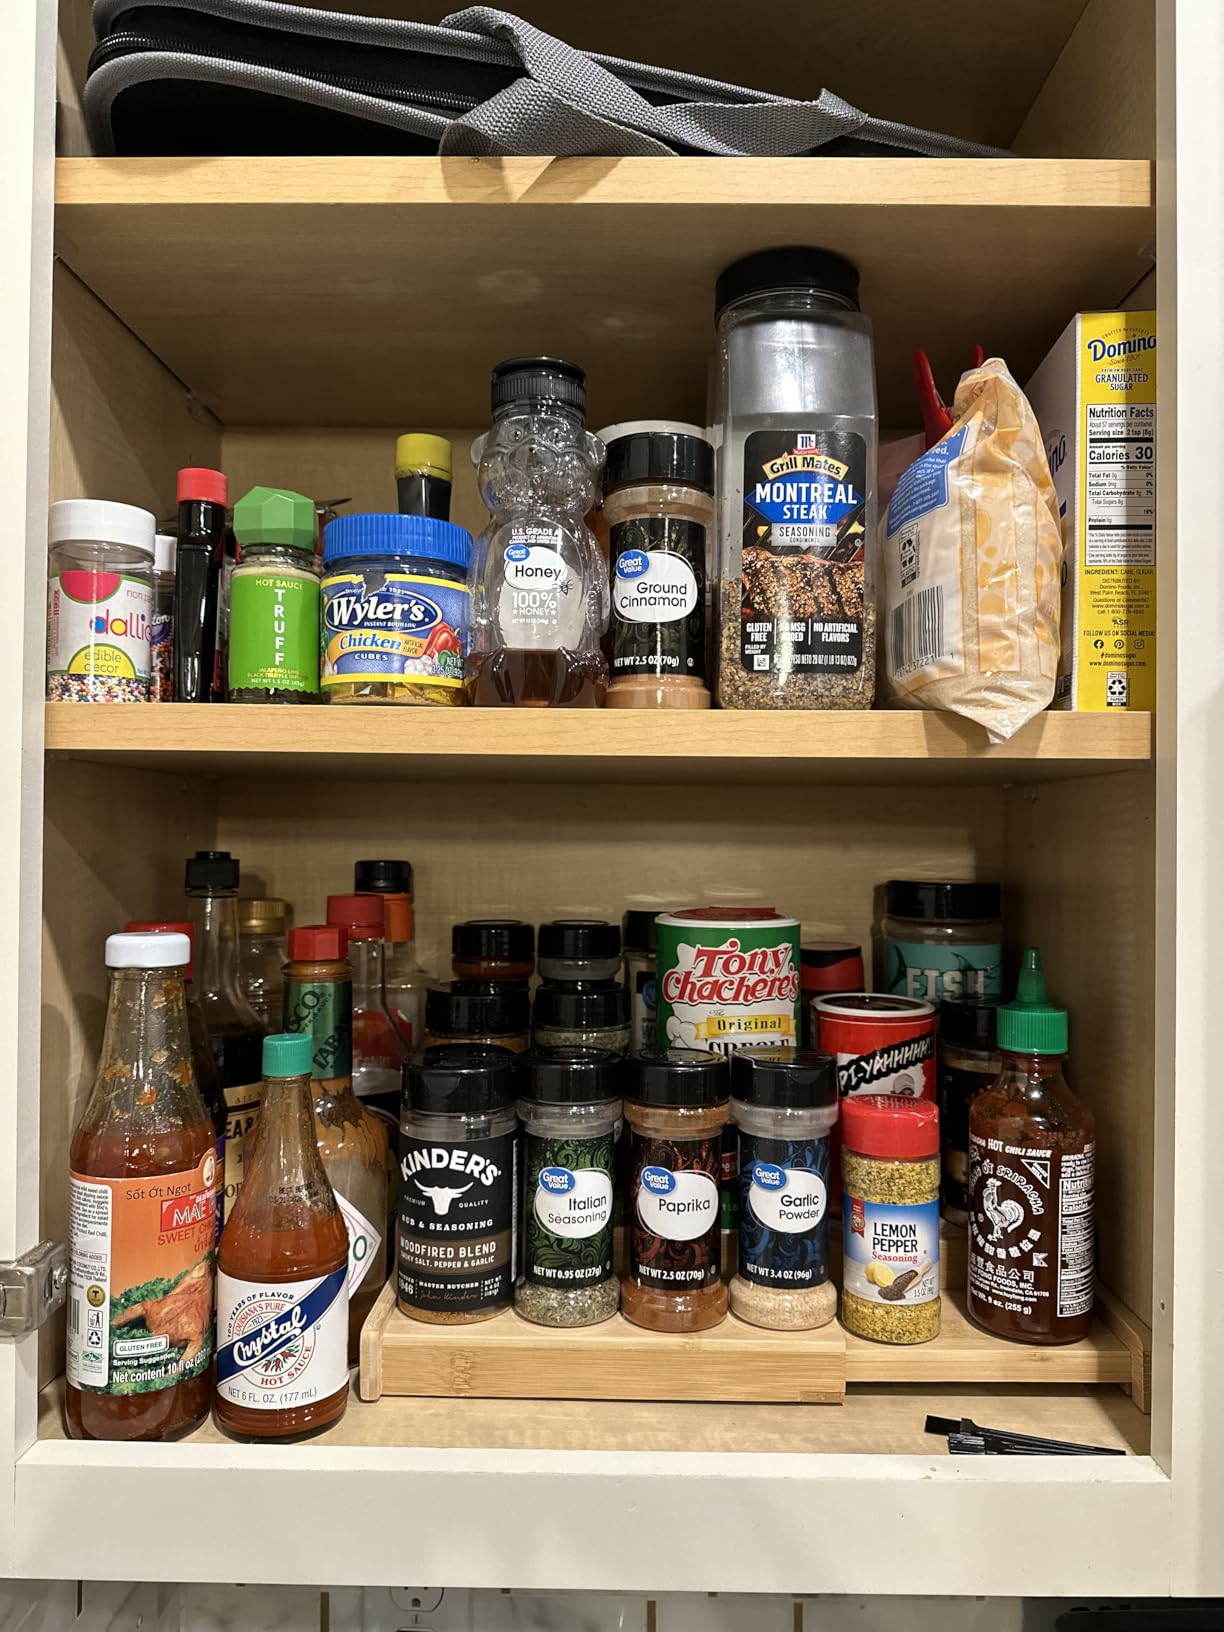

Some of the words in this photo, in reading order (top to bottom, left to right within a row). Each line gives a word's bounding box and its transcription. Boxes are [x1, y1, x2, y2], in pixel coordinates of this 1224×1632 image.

[1088, 336, 1156, 362] Domino
[1096, 374, 1148, 382] GRANULATED
[1089, 408, 1127, 418] Nutrition
[1130, 407, 1154, 418] Facts
[1089, 450, 1130, 460] Calories
[1135, 446, 1153, 460] 30
[770, 457, 798, 474] Grill
[802, 457, 841, 474] Mates
[756, 483, 858, 504] MONTREAL
[784, 504, 828, 519] STEAK
[780, 527, 830, 538] SEASONING
[619, 557, 642, 569] Great
[624, 565, 642, 573] Value
[516, 565, 562, 580] Honey
[276, 580, 303, 590] SAUCE
[636, 582, 687, 595] Ground
[126, 590, 142, 599] non
[512, 592, 557, 608] 100%
[620, 596, 687, 608] Cinnamon
[332, 597, 425, 626] Wyler's
[274, 589, 286, 665] TRUFF
[746, 622, 772, 632] GLUTEN
[790, 622, 806, 632] MSG
[814, 623, 823, 632] NO
[824, 624, 858, 633] ARTIFICIAL
[340, 634, 402, 650] Chicken
[751, 632, 768, 642] FREE
[822, 633, 849, 642] FLAVORS
[85, 652, 122, 662] edible
[614, 658, 624, 667] NET
[624, 657, 634, 666] WT
[635, 656, 647, 665] 2.5
[648, 656, 658, 664] OZ
[660, 656, 679, 666] (70g)
[694, 940, 792, 978] Tony
[664, 964, 799, 1002] Chachere's
[906, 967, 985, 1000] FISH
[718, 1018, 782, 1032] Original
[988, 1138, 1003, 1152] HOT
[1005, 1146, 1026, 1156] CHILI
[1026, 1148, 1052, 1158] SAUCE
[400, 1148, 499, 1186] KINDER'S
[755, 1168, 780, 1180] Great
[543, 1172, 569, 1184] Great
[548, 1181, 568, 1189] Value
[644, 1171, 669, 1184] Great
[761, 1177, 780, 1186] Value
[126, 1186, 145, 1200] Sốt
[167, 1183, 192, 1197] Ngọt
[649, 1181, 669, 1190] Value
[996, 1165, 1044, 1215] SRIRACHA
[459, 1200, 489, 1208] QUALITY
[568, 1195, 607, 1211] Italian
[659, 1198, 710, 1215] Paprika
[780, 1194, 819, 1207] Garlic
[172, 1202, 207, 1227] MAE
[548, 1210, 607, 1225] Seasoning
[779, 1209, 820, 1220] Powder
[402, 1214, 415, 1226] RUB
[429, 1219, 494, 1231] SEASONING
[874, 1222, 916, 1238] LEMON
[158, 1228, 196, 1246] SWEET
[400, 1235, 454, 1258] WOODFIRED
[459, 1242, 497, 1258] BLEND
[872, 1237, 918, 1253] PEPPER
[415, 1258, 432, 1268] SALT,
[434, 1260, 462, 1268] PEPPER
[471, 1256, 495, 1267] GARLIC
[872, 1250, 918, 1264] Seasoning
[534, 1265, 545, 1276] NET
[546, 1269, 557, 1279] WT
[557, 1269, 574, 1279] 0.95
[575, 1269, 585, 1279] OZ
[585, 1265, 602, 1278] (27g)
[639, 1264, 650, 1276] NET
[650, 1268, 662, 1278] WT
[662, 1269, 674, 1280] 2.5
[676, 1270, 686, 1280] OZ
[686, 1269, 704, 1281] (70g)
[746, 1262, 757, 1274] NET
[758, 1266, 770, 1276] WT
[770, 1269, 782, 1279] 3.4
[783, 1270, 793, 1280] OZ
[794, 1269, 812, 1280] (96g)
[971, 1252, 1034, 1282] 食品公司
[419, 1280, 445, 1289] MASTER
[447, 1281, 479, 1290] BUTCHER
[993, 1275, 1018, 1288] FOODS,
[1020, 1282, 1034, 1290] INC.
[230, 1300, 246, 1321] YEARS
[246, 1293, 257, 1302] OF
[259, 1292, 295, 1300] FLAVOR
[994, 1299, 1004, 1308] oz.
[1005, 1302, 1022, 1312] (255
[1023, 1306, 1032, 1315] g)
[234, 1303, 264, 1336] LOUISIANA'S
[265, 1302, 286, 1311] PURE
[251, 1315, 264, 1327] 1923
[233, 1305, 307, 1366] Crystal
[120, 1344, 145, 1352] GLUTEN
[146, 1340, 163, 1350] FREE
[113, 1358, 138, 1367] Serving
[139, 1352, 175, 1365] Suggestion
[260, 1376, 285, 1386] HOT
[288, 1345, 313, 1380] SAUCE
[113, 1371, 129, 1383] Net
[130, 1367, 165, 1382] content
[167, 1364, 177, 1375] 10
[178, 1359, 184, 1372] fl
[186, 1361, 194, 1370] oz
[228, 1386, 240, 1396] NET
[242, 1391, 247, 1399] 6
[248, 1393, 260, 1403] FL.
[262, 1394, 278, 1403] OZ.
[280, 1392, 300, 1404] (177
[302, 1387, 317, 1400] mL)
